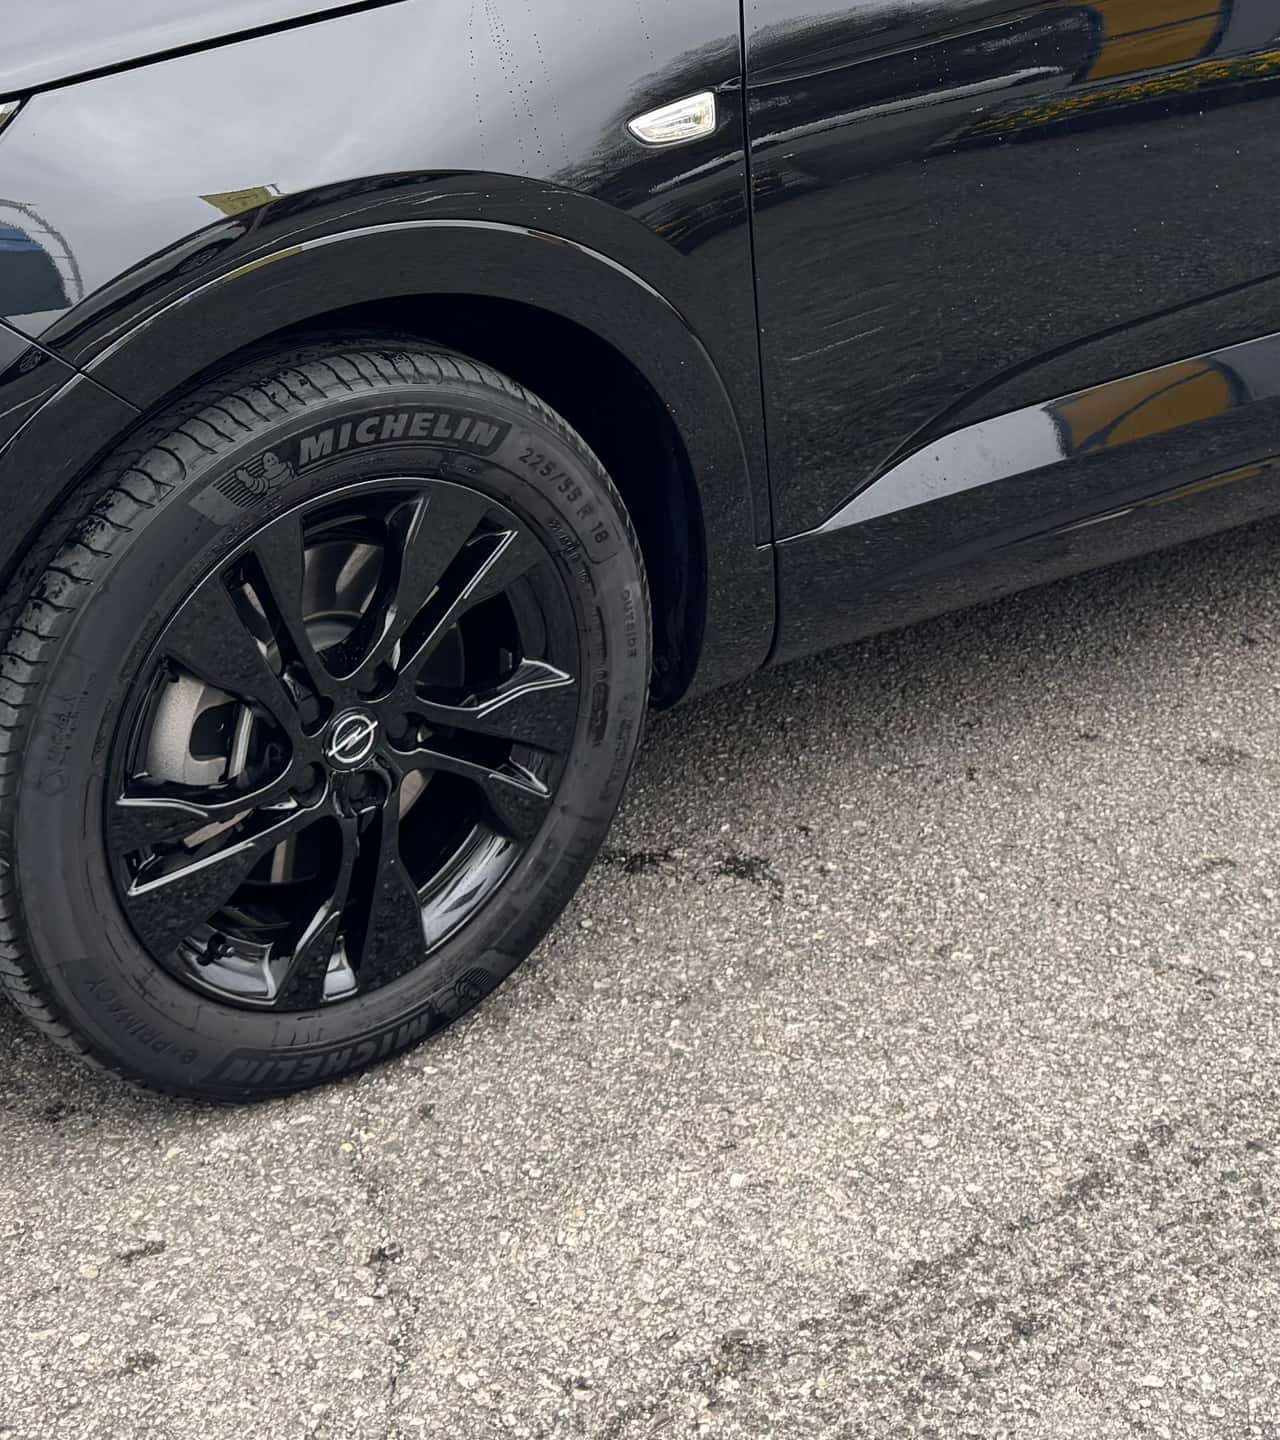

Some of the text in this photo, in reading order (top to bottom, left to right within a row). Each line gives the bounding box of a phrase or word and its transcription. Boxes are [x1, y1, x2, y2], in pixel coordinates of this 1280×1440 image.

[298, 412, 501, 463] MICHELIN
[520, 447, 583, 506] 225/55
[591, 521, 609, 544] 18
